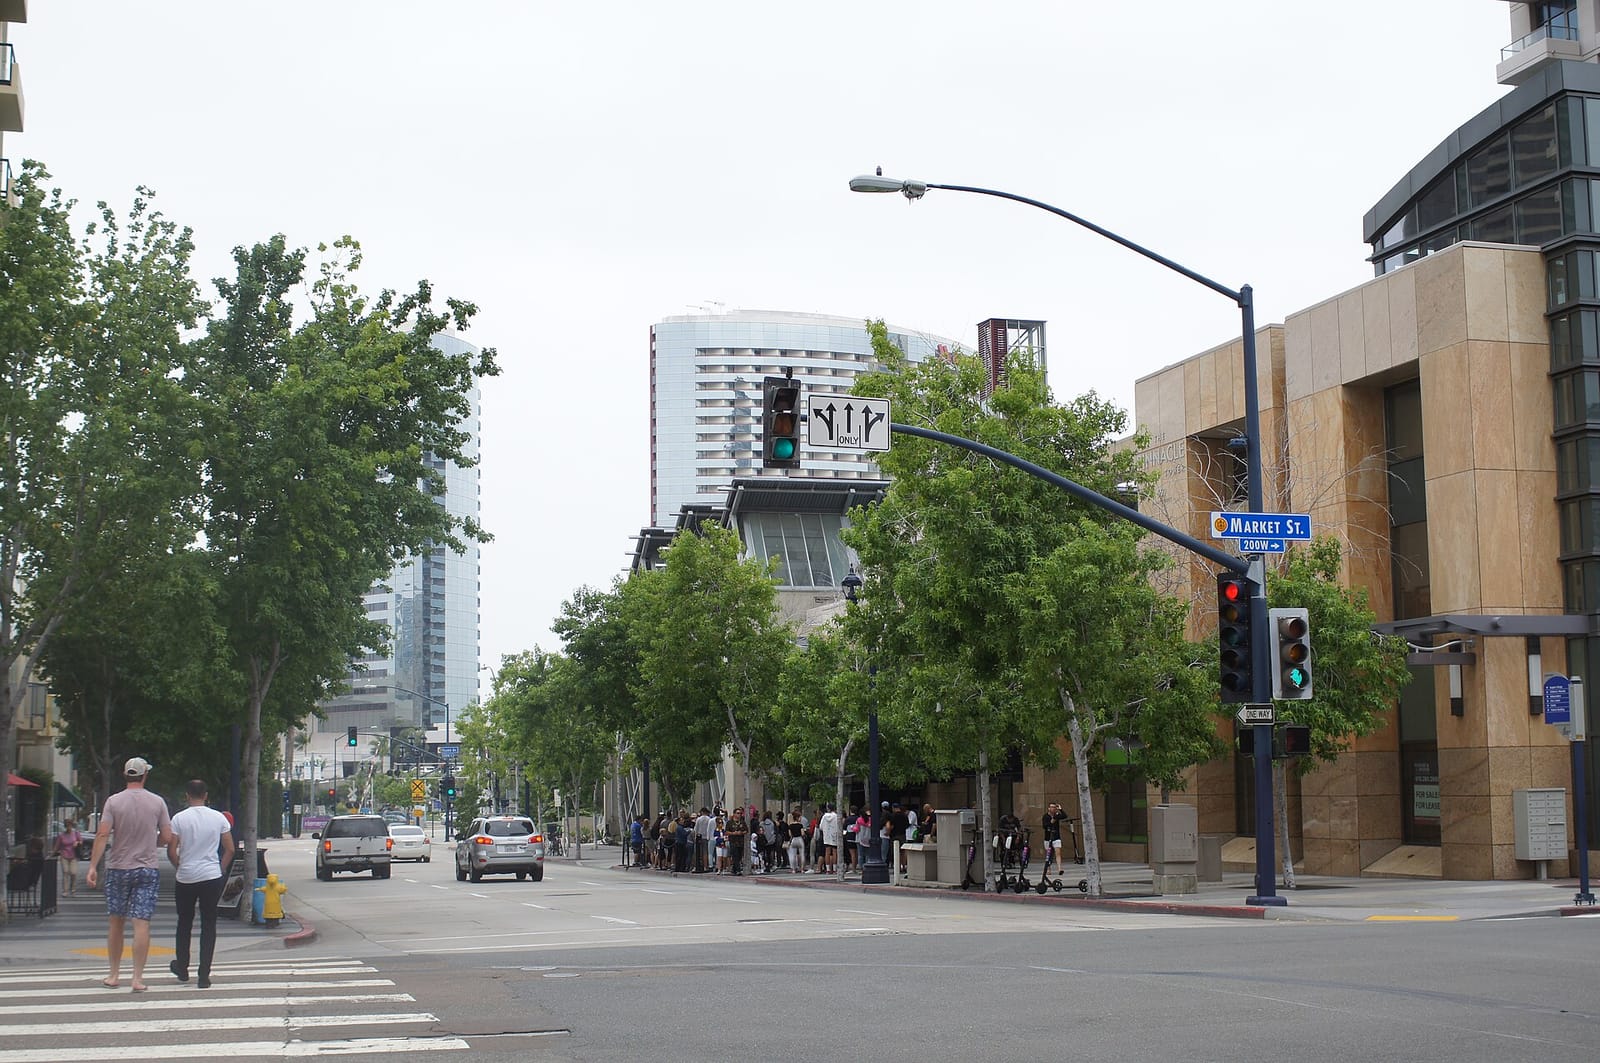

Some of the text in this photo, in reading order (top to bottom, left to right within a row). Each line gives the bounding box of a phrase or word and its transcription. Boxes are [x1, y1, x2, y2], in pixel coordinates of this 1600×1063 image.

[839, 435, 859, 445] ONLY
[1230, 517, 1305, 535] MARKET ST.
[1243, 540, 1269, 550] 200W
[1246, 710, 1271, 719] ONE WAY
[1415, 801, 1425, 809] FOR
